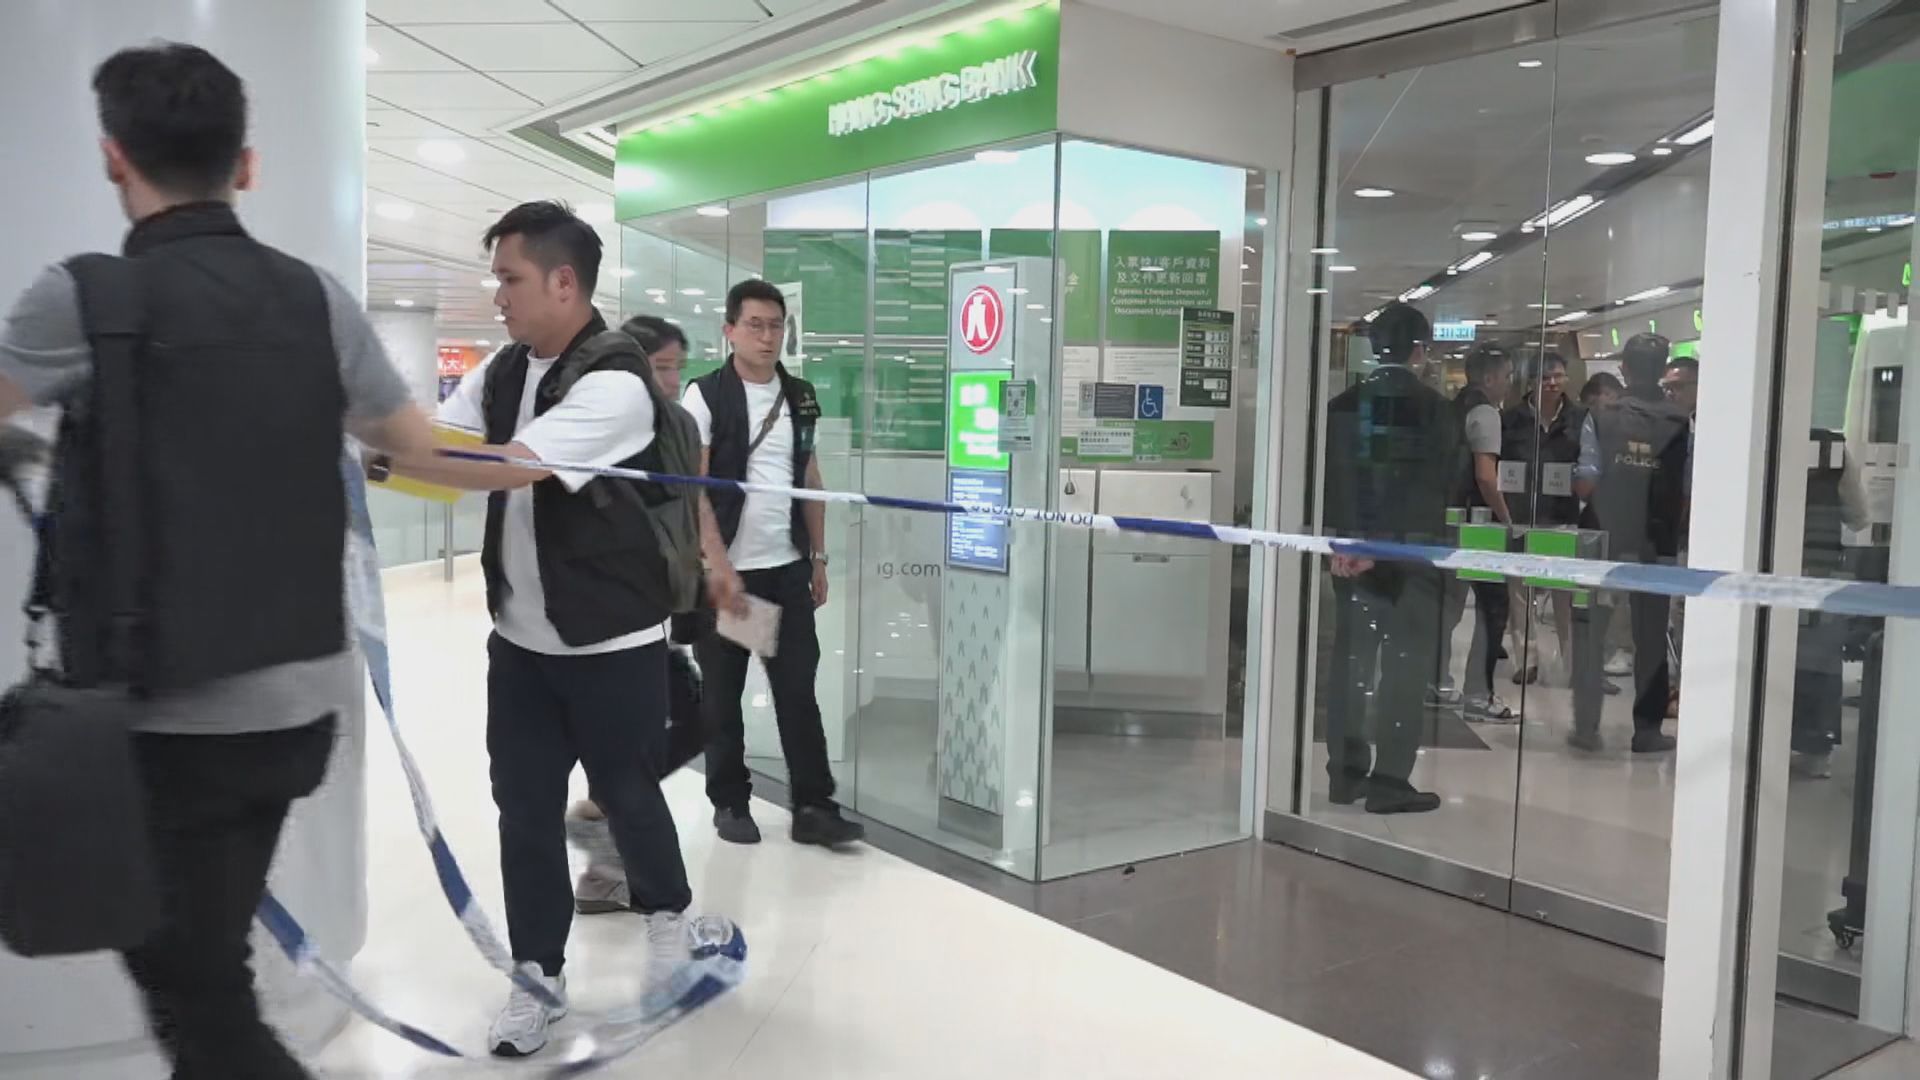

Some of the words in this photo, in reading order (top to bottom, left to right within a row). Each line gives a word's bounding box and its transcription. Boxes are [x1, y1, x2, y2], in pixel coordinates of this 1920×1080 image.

[960, 49, 1038, 103] BANK
[1113, 287, 1143, 297] Express
[1144, 287, 1174, 297] Cheque
[1110, 296, 1147, 306] Customer
[1148, 296, 1195, 306] Information
[1196, 298, 1212, 306] and
[1114, 306, 1154, 315] Document
[1615, 453, 1660, 470] POLICE
[1032, 510, 1067, 523] NOT
[1070, 514, 1093, 527] DO
